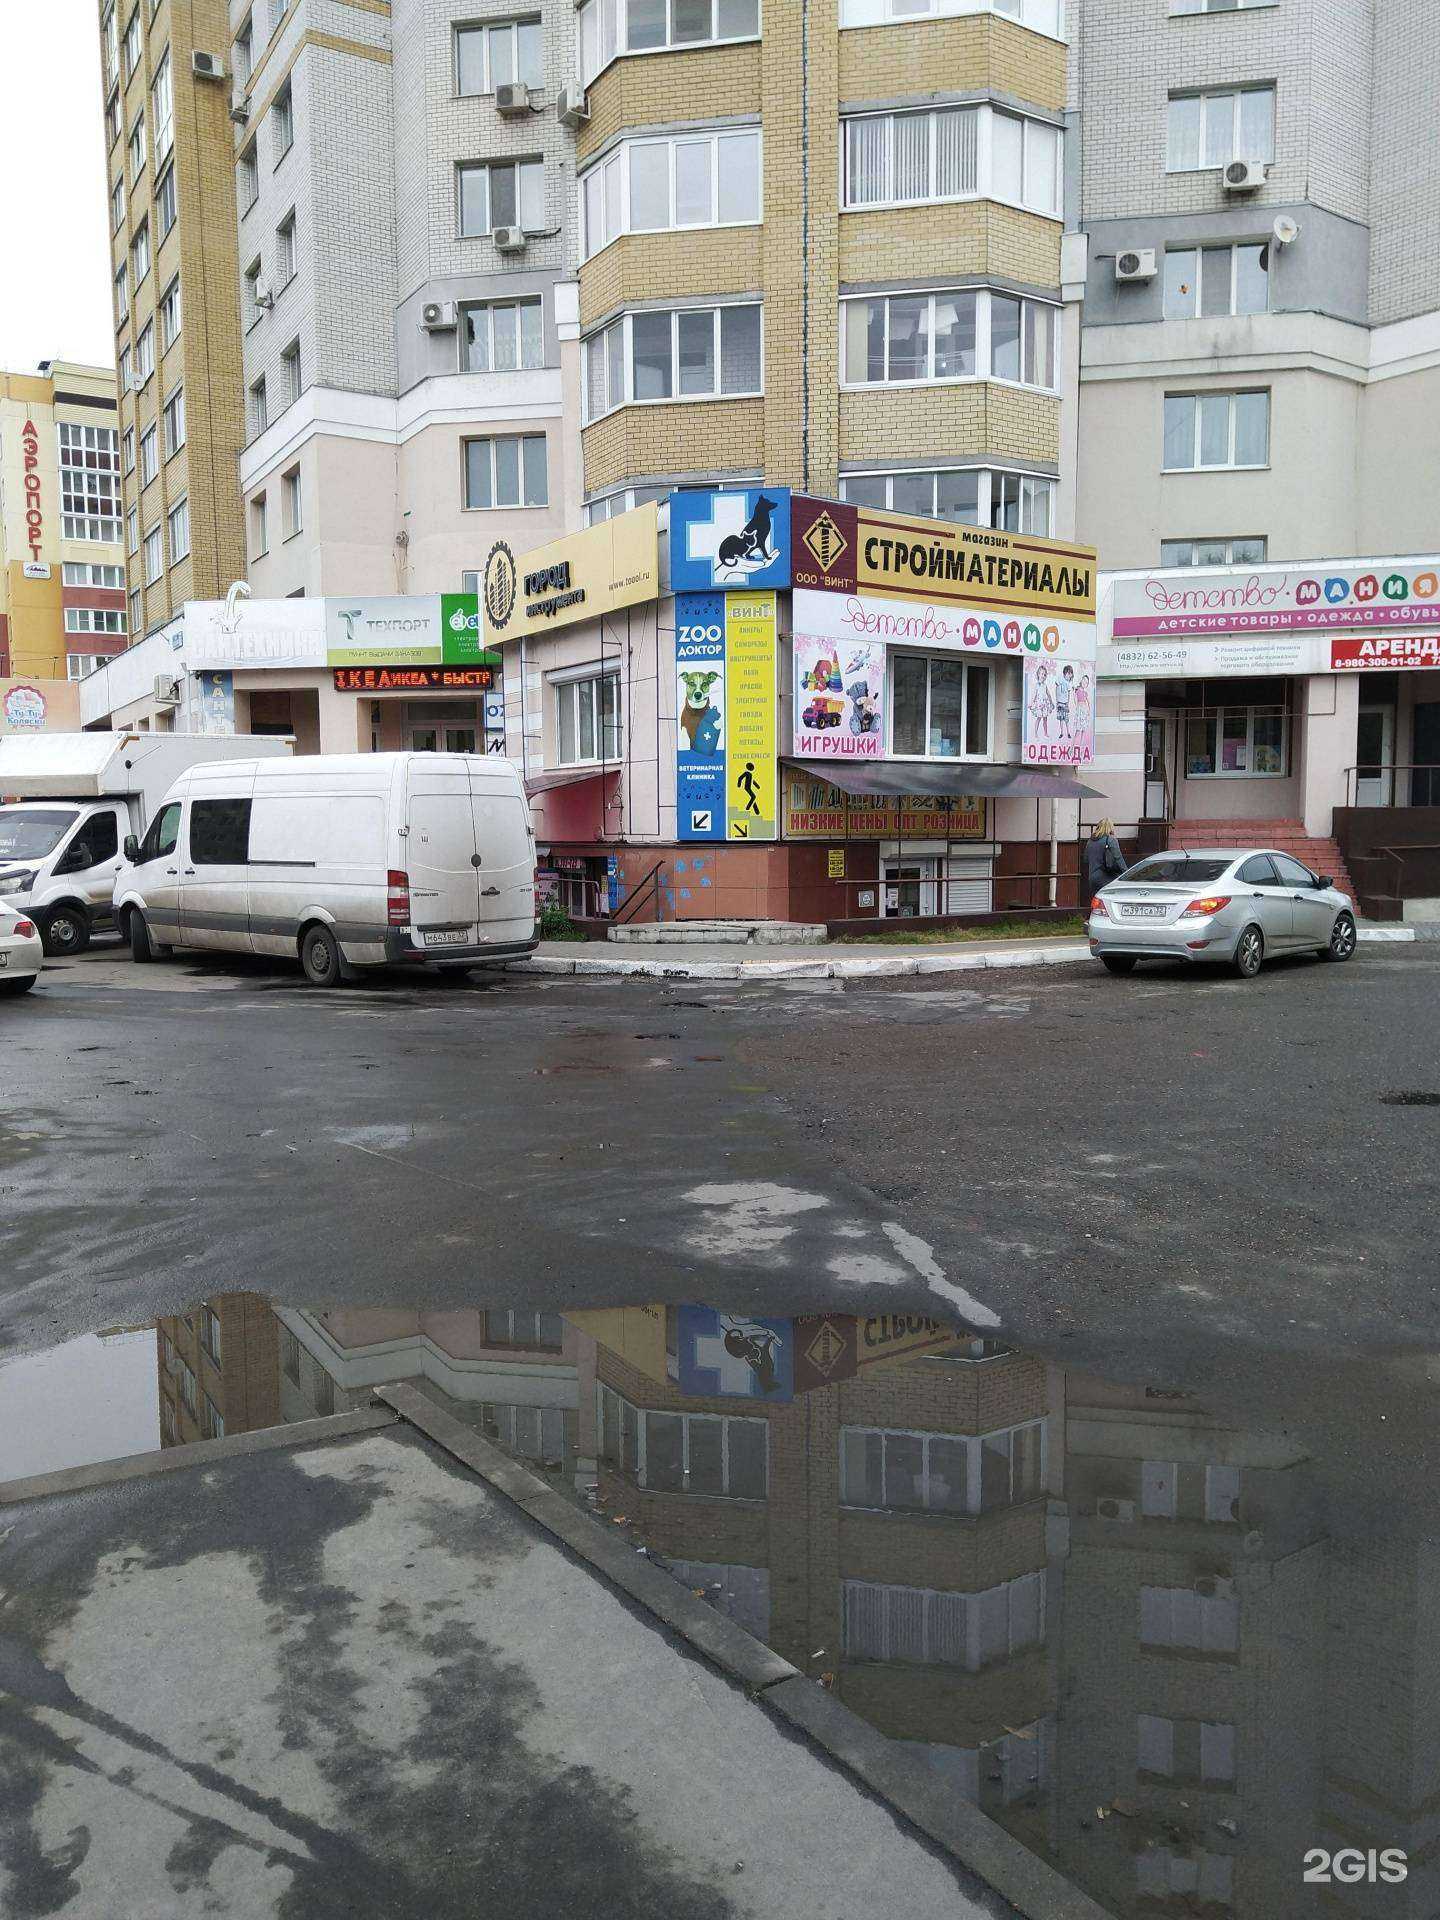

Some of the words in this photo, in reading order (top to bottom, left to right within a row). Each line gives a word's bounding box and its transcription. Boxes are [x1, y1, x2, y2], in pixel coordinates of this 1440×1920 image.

[21, 419, 43, 562] АЭРОПОРТ
[864, 537, 1090, 598] СТРОЙМАТЕРИАЛЫ
[523, 561, 571, 597] ГОРОД
[796, 573, 818, 585] ООО
[1296, 572, 1439, 605] МАНИЯ
[366, 619, 430, 633] ТЕХПОРТ
[1158, 616, 1227, 631] детские
[1230, 613, 1292, 628] товары
[1307, 608, 1374, 624] одежда
[678, 625, 722, 643] ZOO
[962, 617, 1060, 652] МАНИЯ
[677, 645, 723, 658] ДОКТОР
[1117, 651, 1146, 662] (4832)
[1147, 650, 1188, 661] 62-56-49
[1359, 638, 1440, 656] АРЕНД
[800, 736, 877, 755] ИГРУШКИ
[1028, 744, 1091, 764] ОДЕЖДА
[790, 813, 844, 830] НИЗКИЕ
[849, 813, 888, 832] ЦЕНЫ
[893, 813, 917, 830] ОПТ
[923, 813, 980, 831] РОЗНИЦА
